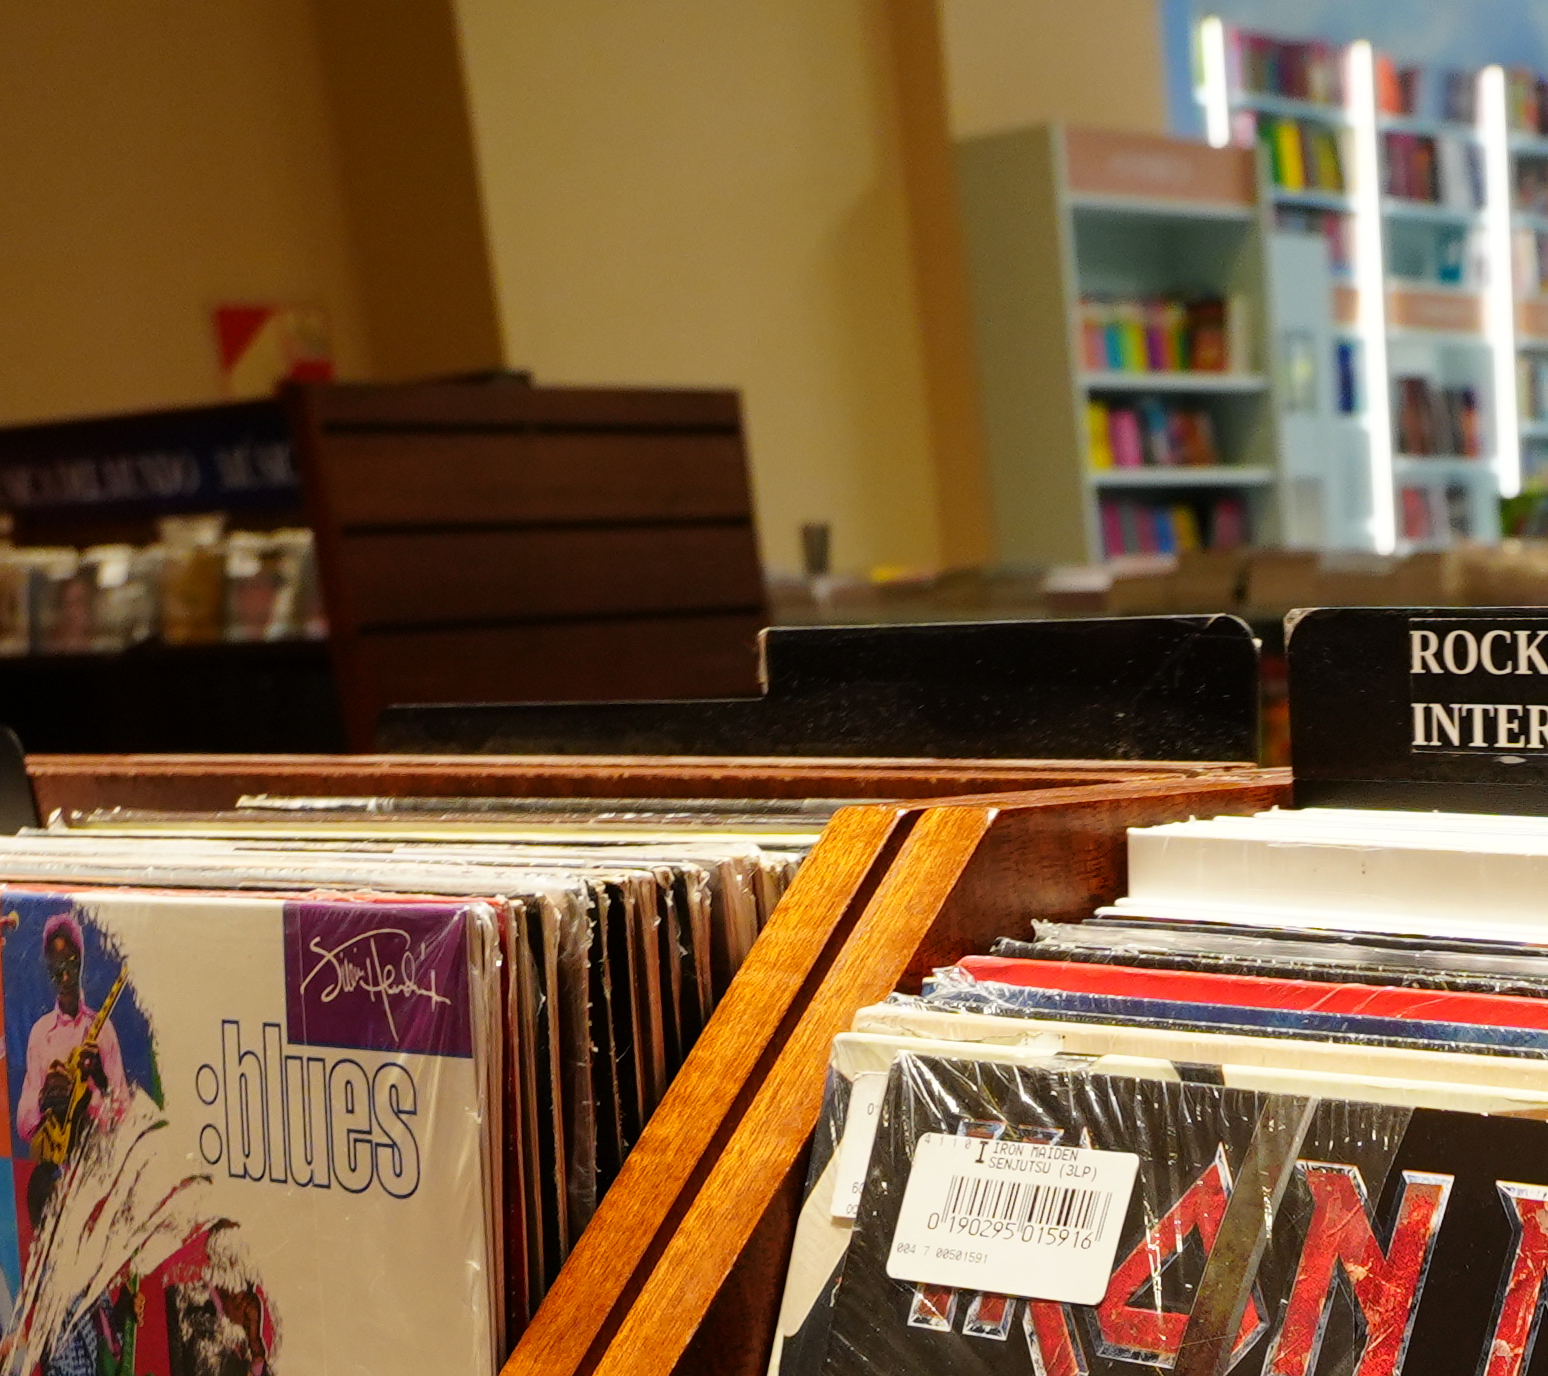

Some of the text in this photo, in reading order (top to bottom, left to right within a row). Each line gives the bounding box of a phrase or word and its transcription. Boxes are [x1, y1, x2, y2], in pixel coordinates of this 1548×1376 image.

[992, 1143, 1023, 1157] IRON
[1029, 1147, 1079, 1162] MAIDEN
[988, 1157, 1098, 1182] SENJUTSU (3LP)
[949, 1215, 1017, 1241] 190295
[1021, 1224, 1094, 1250] 015916
